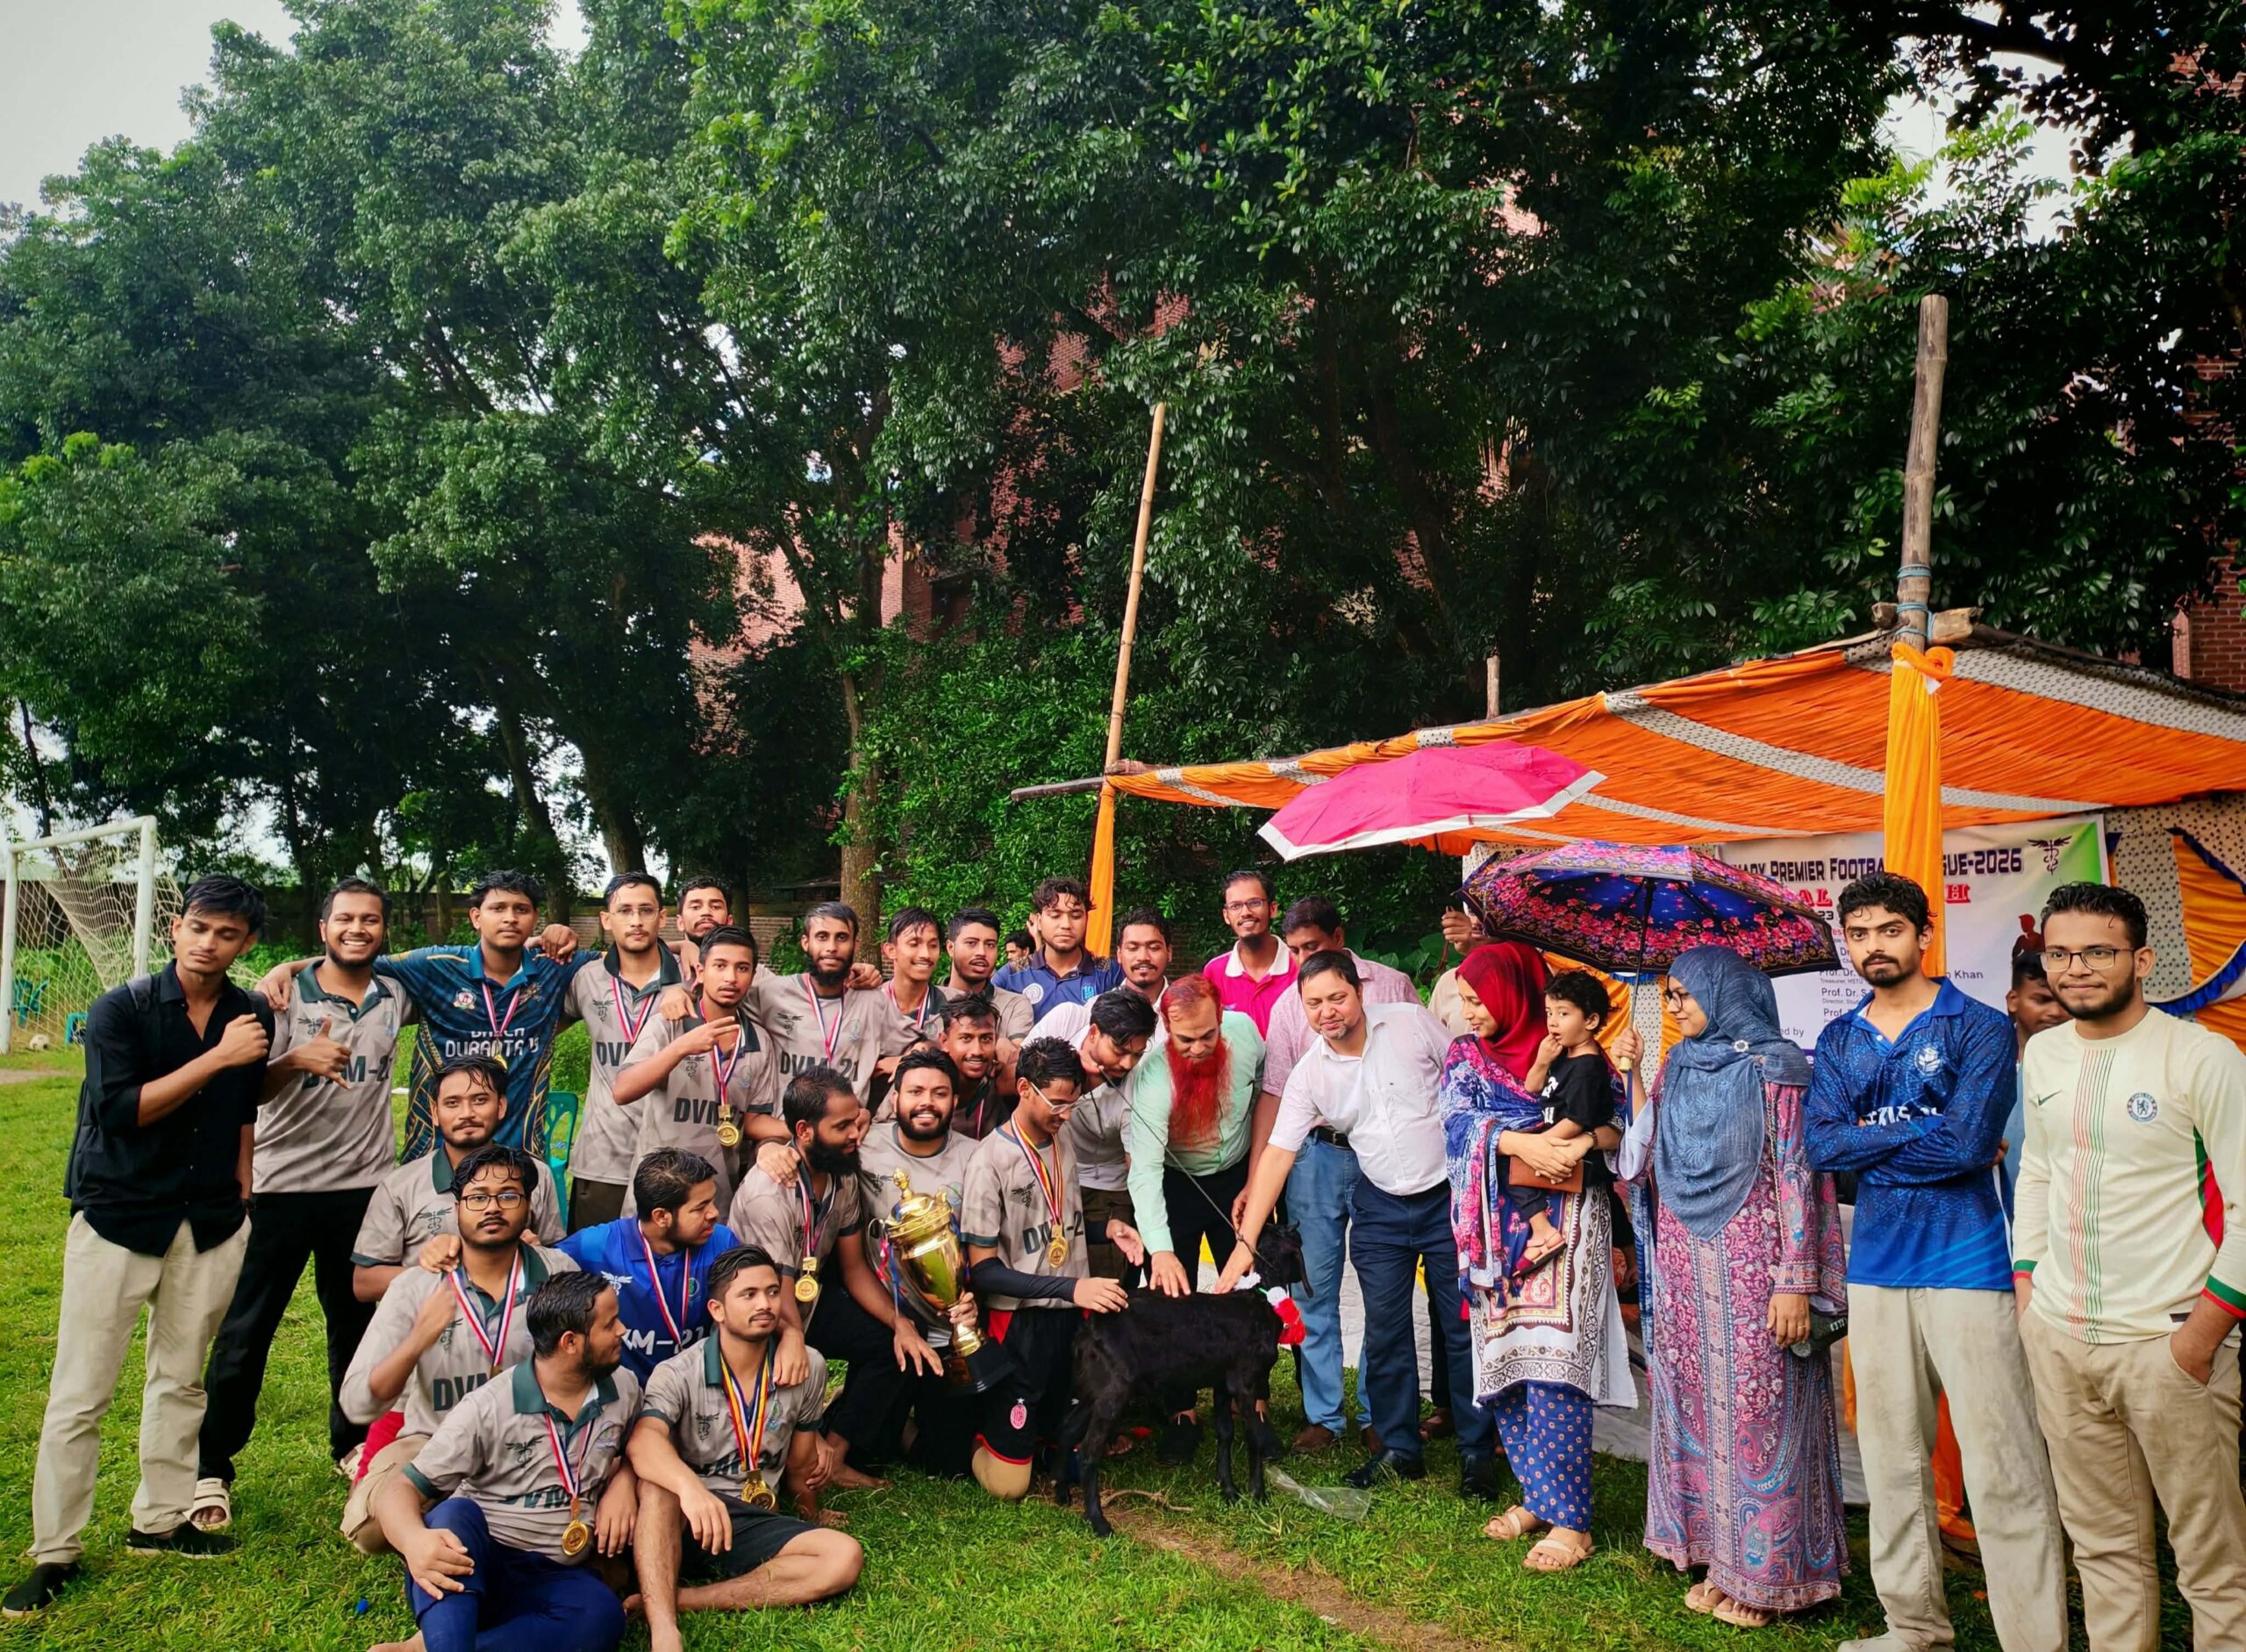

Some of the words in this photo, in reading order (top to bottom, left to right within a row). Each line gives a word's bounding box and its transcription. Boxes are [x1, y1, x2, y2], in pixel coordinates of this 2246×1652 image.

[1770, 860, 1825, 882] PREMIER
[1954, 969, 1983, 979] Khan
[1793, 1027, 1805, 1037] by
